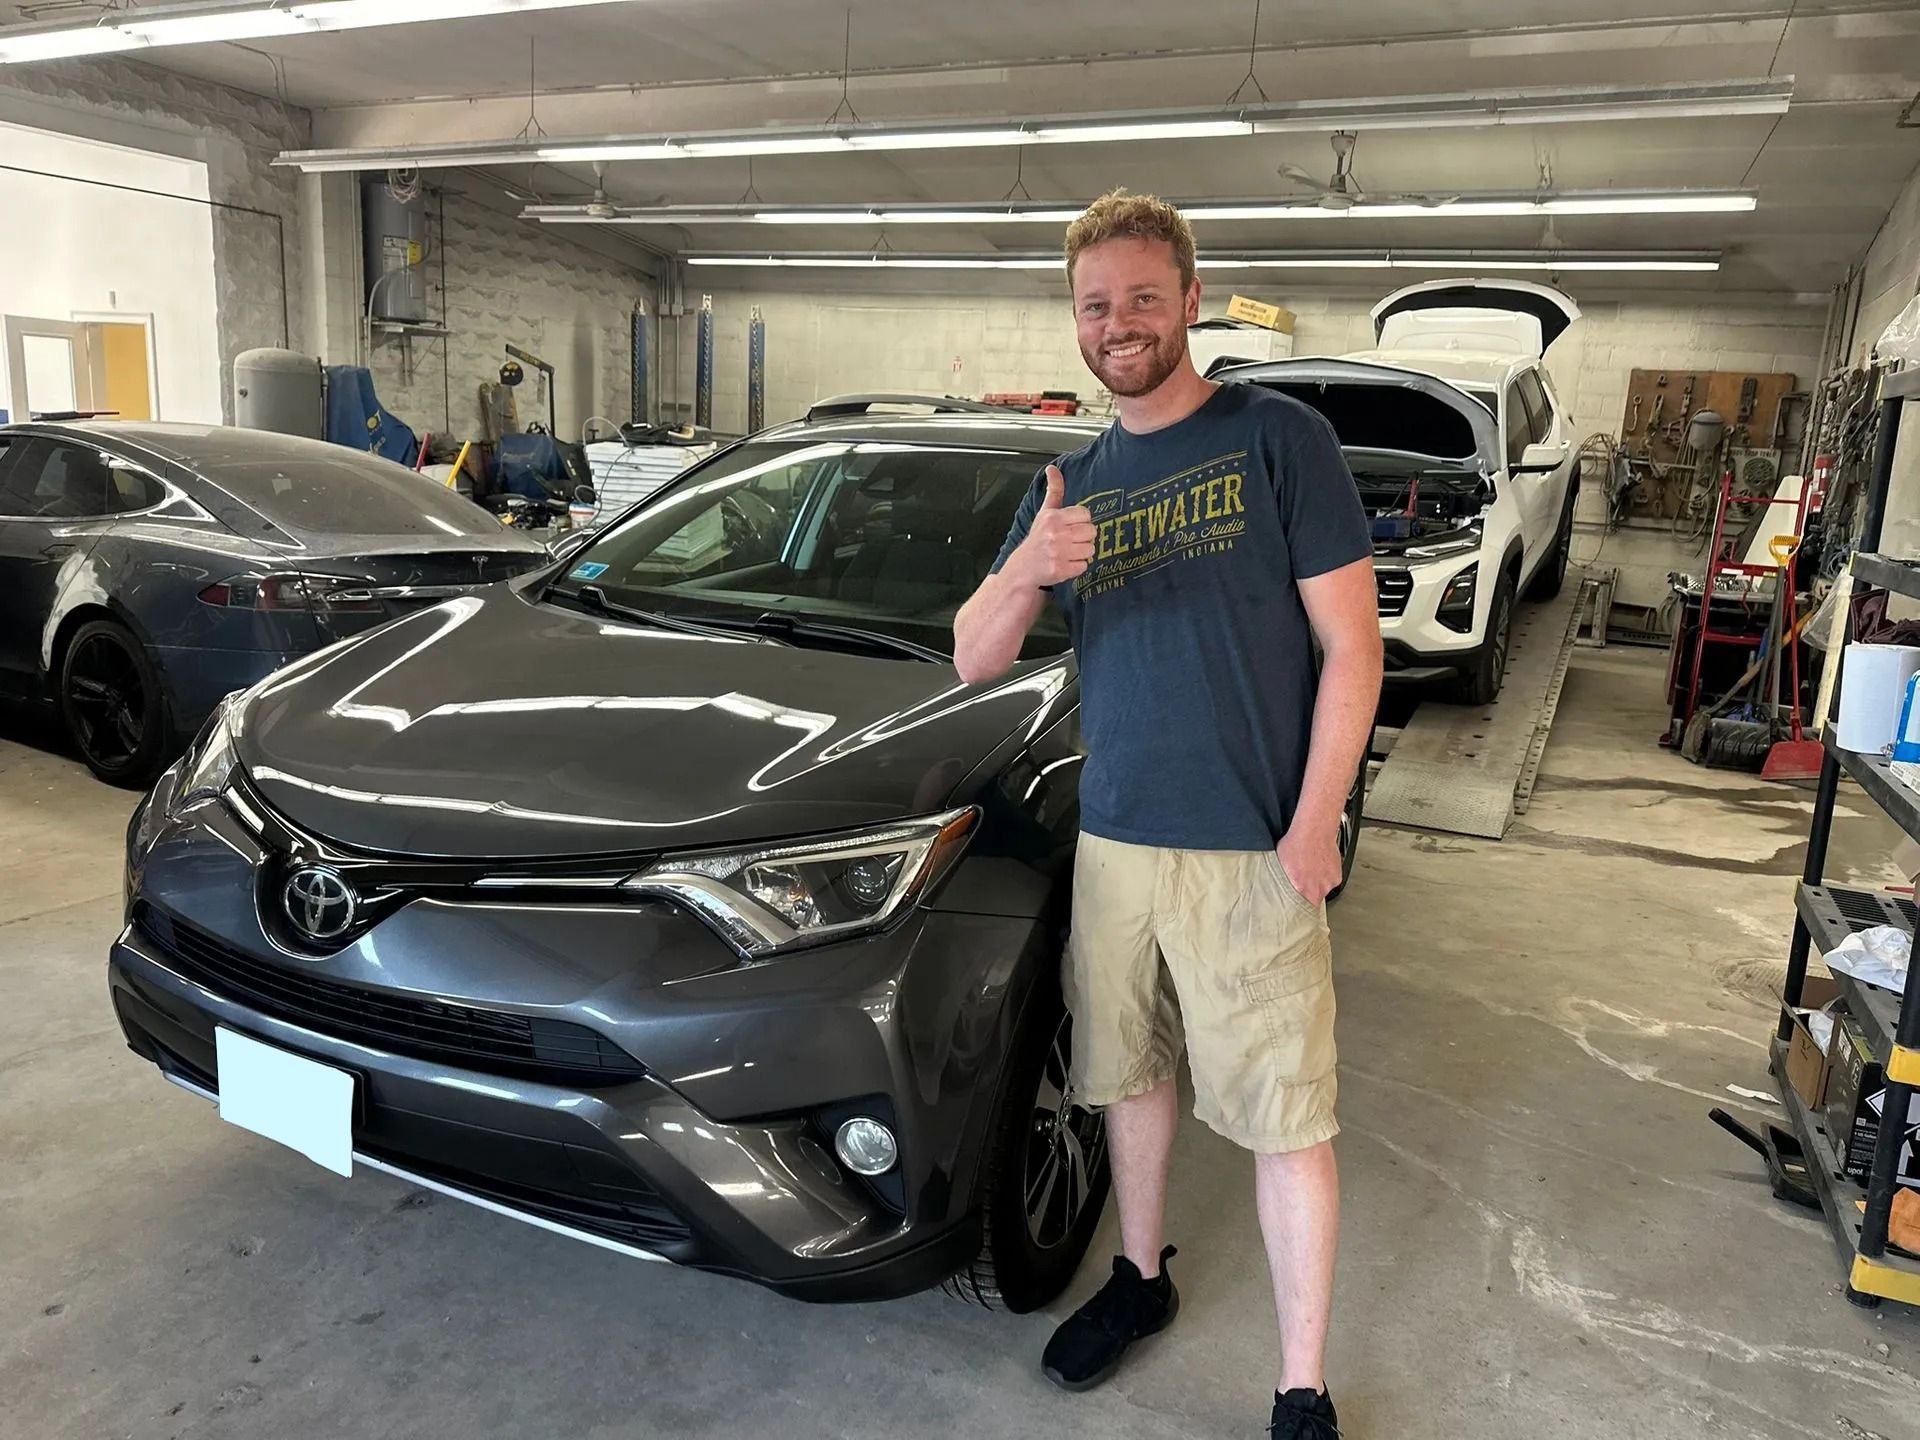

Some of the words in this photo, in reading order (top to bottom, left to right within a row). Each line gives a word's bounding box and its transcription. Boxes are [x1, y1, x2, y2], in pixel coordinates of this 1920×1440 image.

[1088, 473, 1245, 564] EETWATER
[1094, 498, 1118, 514] 1979
[1096, 546, 1160, 579] Instruments
[1174, 530, 1196, 547] Pro
[1201, 518, 1246, 537] Audio
[1096, 576, 1125, 594] WAYNE
[1183, 539, 1233, 560] INDIANA
